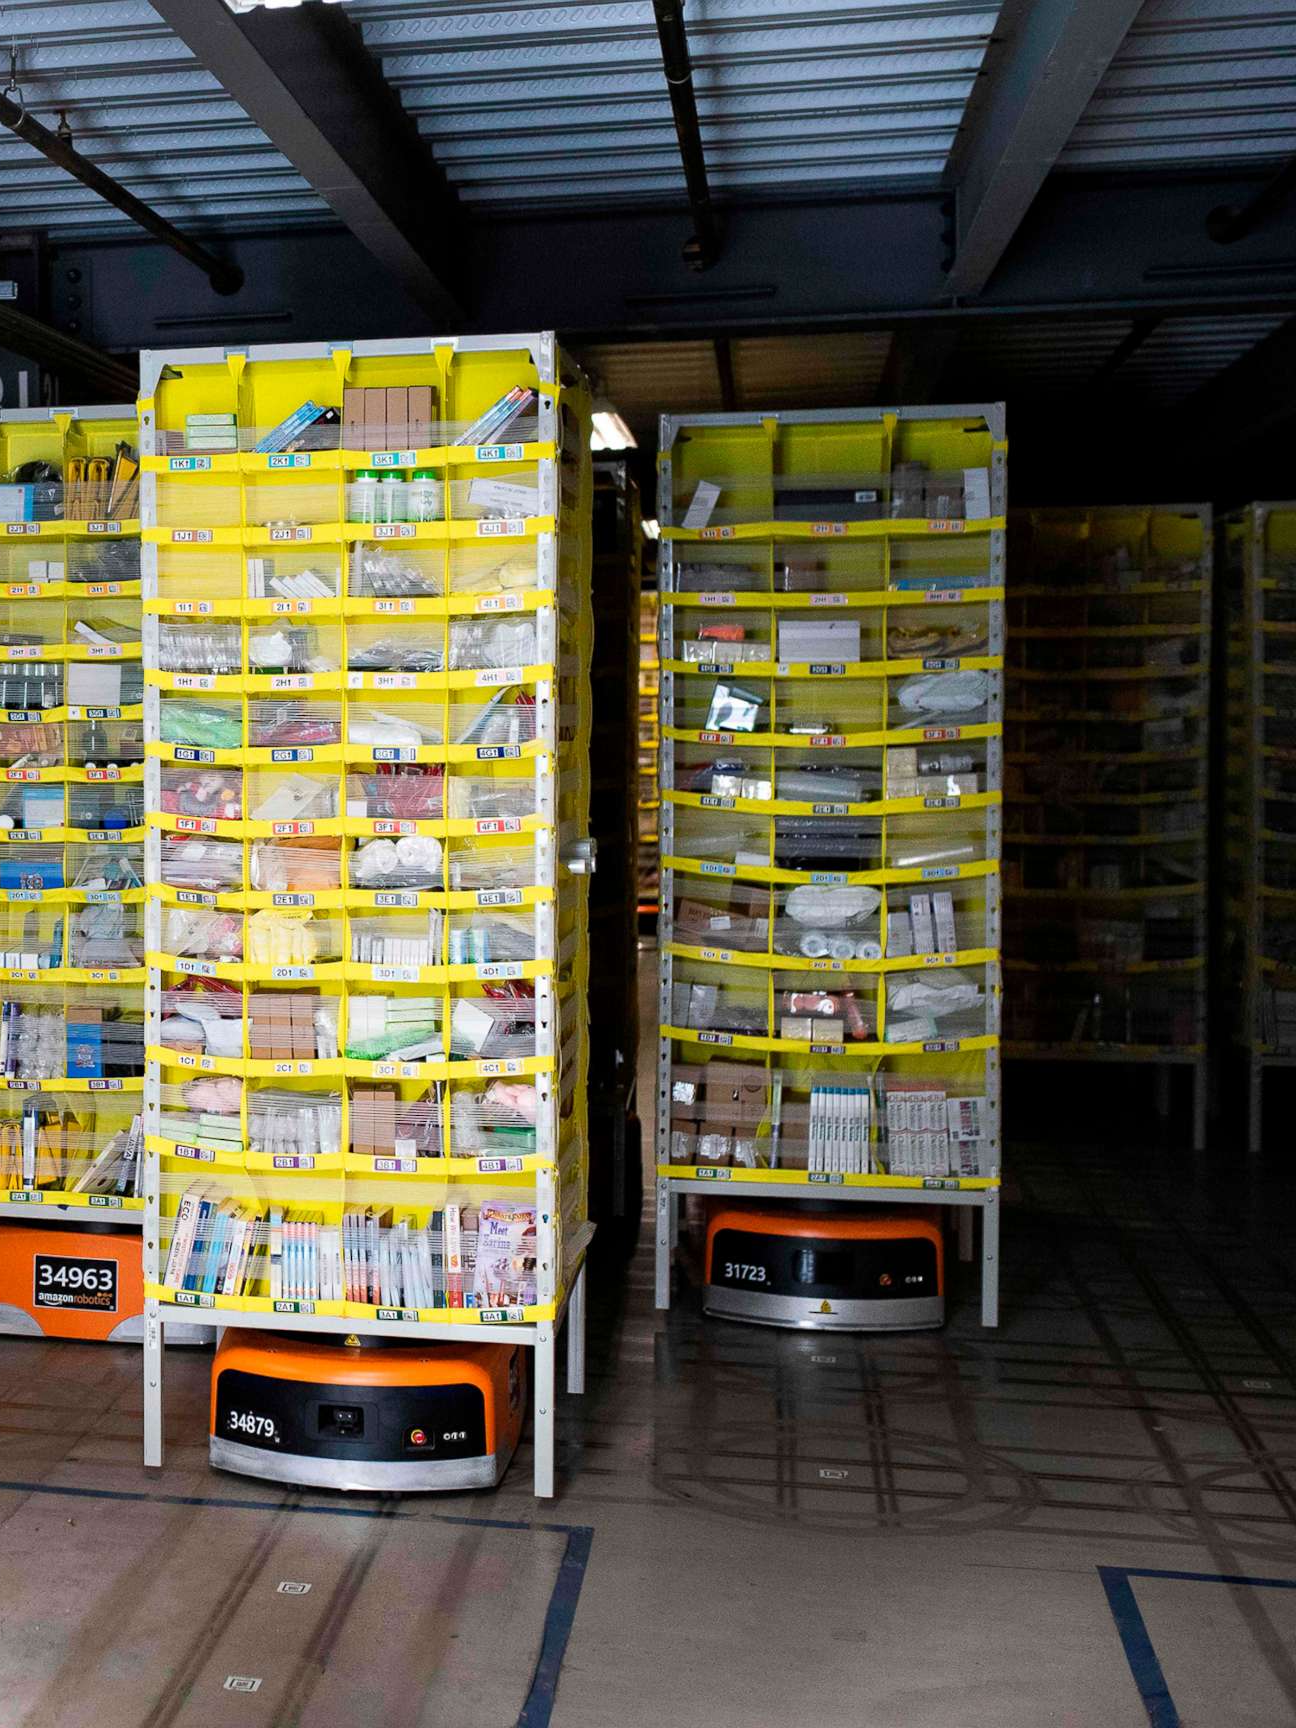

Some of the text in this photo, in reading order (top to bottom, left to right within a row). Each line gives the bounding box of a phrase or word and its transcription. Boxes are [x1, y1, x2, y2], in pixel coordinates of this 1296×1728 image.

[482, 449, 494, 457] 4K
[272, 457, 284, 465] 2K
[377, 455, 388, 464] 3K
[174, 460, 185, 468] 1K
[379, 527, 389, 535] 3J
[485, 523, 495, 531] 4J
[177, 531, 186, 539] 1J
[275, 530, 285, 538] 2J
[379, 602, 388, 610] 3I
[276, 678, 287, 686] 2H
[378, 677, 389, 685] 3H
[178, 750, 189, 758] 1G
[275, 752, 287, 760] 2G
[480, 749, 493, 757] 4G
[180, 820, 190, 828] 1F
[277, 824, 287, 832] 2F
[378, 823, 389, 831] 3F
[481, 822, 492, 830] 4F
[181, 892, 191, 900] 1E
[379, 895, 390, 903] 3E
[482, 894, 494, 902] 4E
[180, 963, 190, 971] 1D
[483, 967, 494, 975] 4D
[180, 1056, 191, 1064] 1C
[276, 1064, 288, 1072] 2C
[379, 1066, 391, 1074] 3C
[483, 1064, 495, 1072] 4C
[123, 1138, 136, 1160] JAVA
[179, 1147, 189, 1156] 1B
[277, 1159, 288, 1167] 2B
[482, 1162, 494, 1170] 4B
[181, 1200, 191, 1221] ECO
[724, 1262, 766, 1282] 31723
[38, 1264, 113, 1290] 34963
[178, 1294, 189, 1302] 1A
[277, 1303, 288, 1311] 2A
[484, 1312, 496, 1320] 4A
[230, 1410, 274, 1437] 34879
